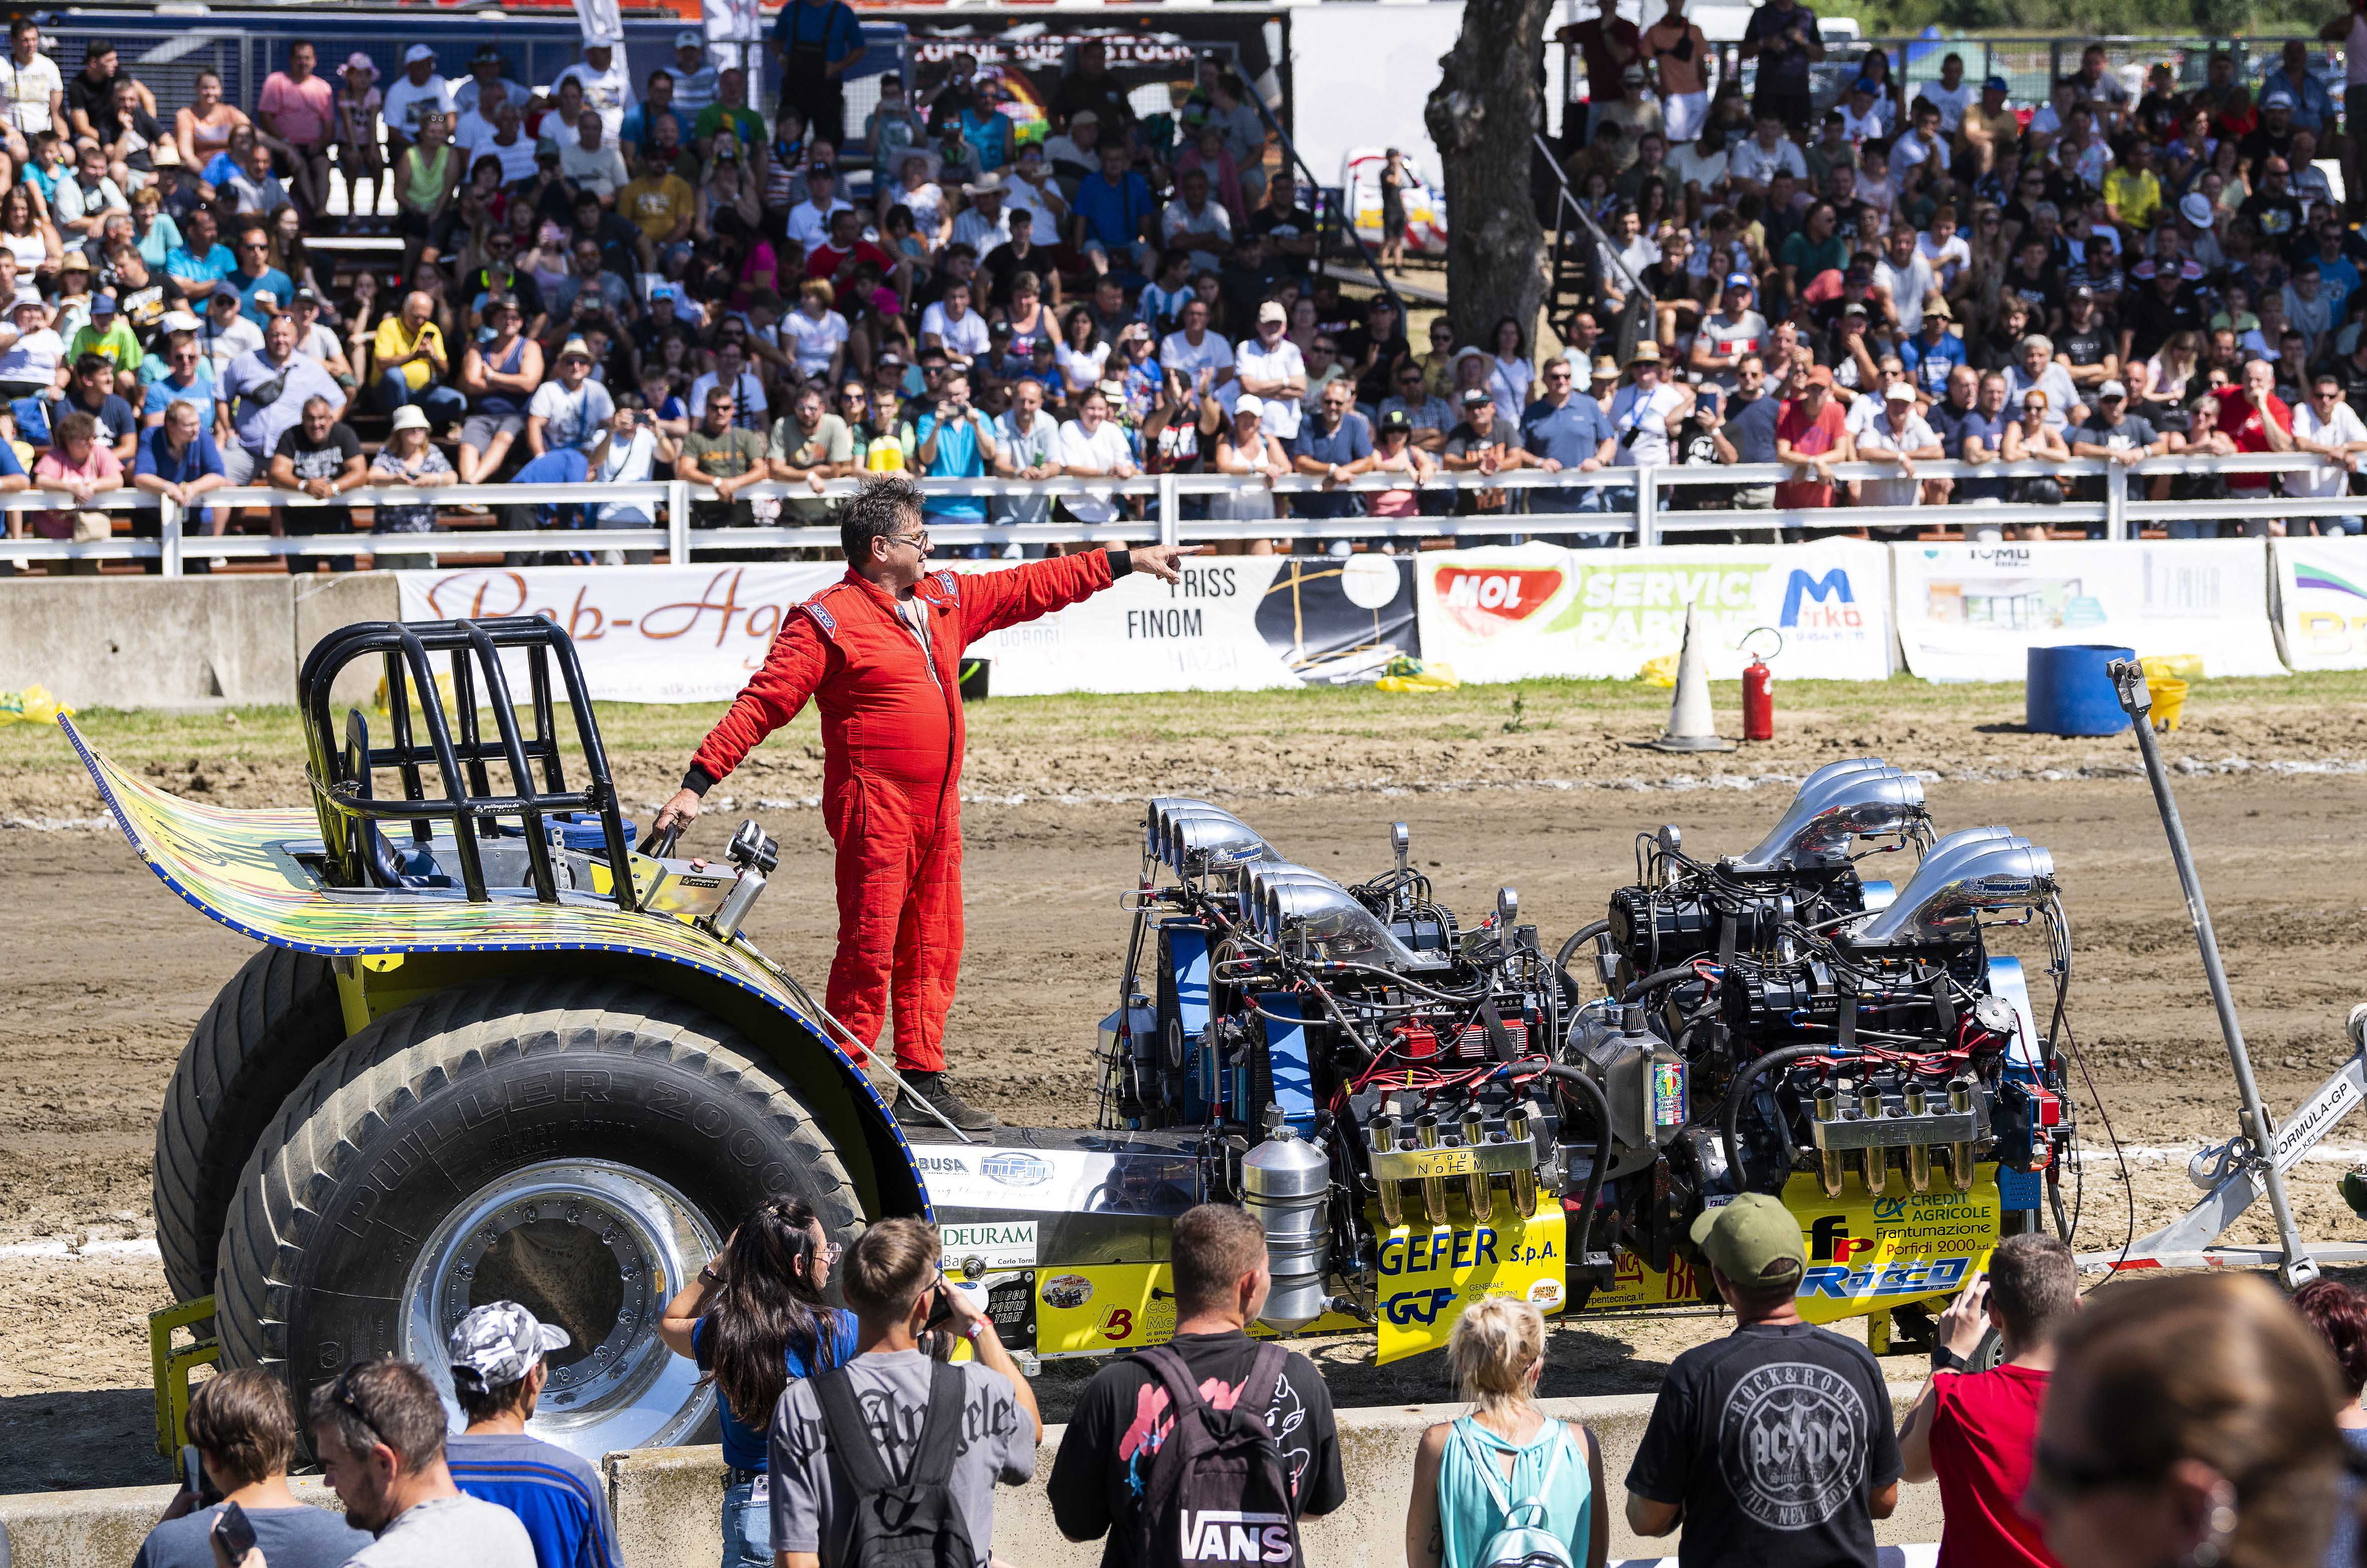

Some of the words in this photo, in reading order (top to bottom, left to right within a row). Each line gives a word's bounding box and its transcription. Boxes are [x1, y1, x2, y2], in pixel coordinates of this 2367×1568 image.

[1447, 575, 1522, 609] MOL
[1128, 608, 1203, 639] FINOM
[1983, 883, 2030, 891] PNEUMATICA
[1663, 1076, 1672, 1097] 1
[2279, 1083, 2348, 1155] ORMULA-GP
[2302, 1133, 2319, 1150] KFT.
[1433, 1152, 1480, 1162] FOUR
[1912, 1205, 1992, 1222] AGRICOLE
[942, 1226, 1035, 1246] DEURAM
[1876, 1222, 1991, 1239] Frantumazione
[1377, 1228, 1499, 1276] GEFER
[1886, 1242, 1932, 1255] Porfidi
[1937, 1238, 1976, 1253] 2000
[1050, 1276, 1073, 1285] TRACTOR
[1065, 1278, 1085, 1286] PULLING
[1469, 1281, 1504, 1291] GENERALE
[990, 1289, 1027, 1302] ROCCO
[1469, 1289, 1518, 1301] COSUZIONI
[989, 1300, 1027, 1313] POWER
[994, 1312, 1023, 1324] TEAM
[855, 1384, 1019, 1458] Aneles
[1180, 1508, 1293, 1563] VANS
